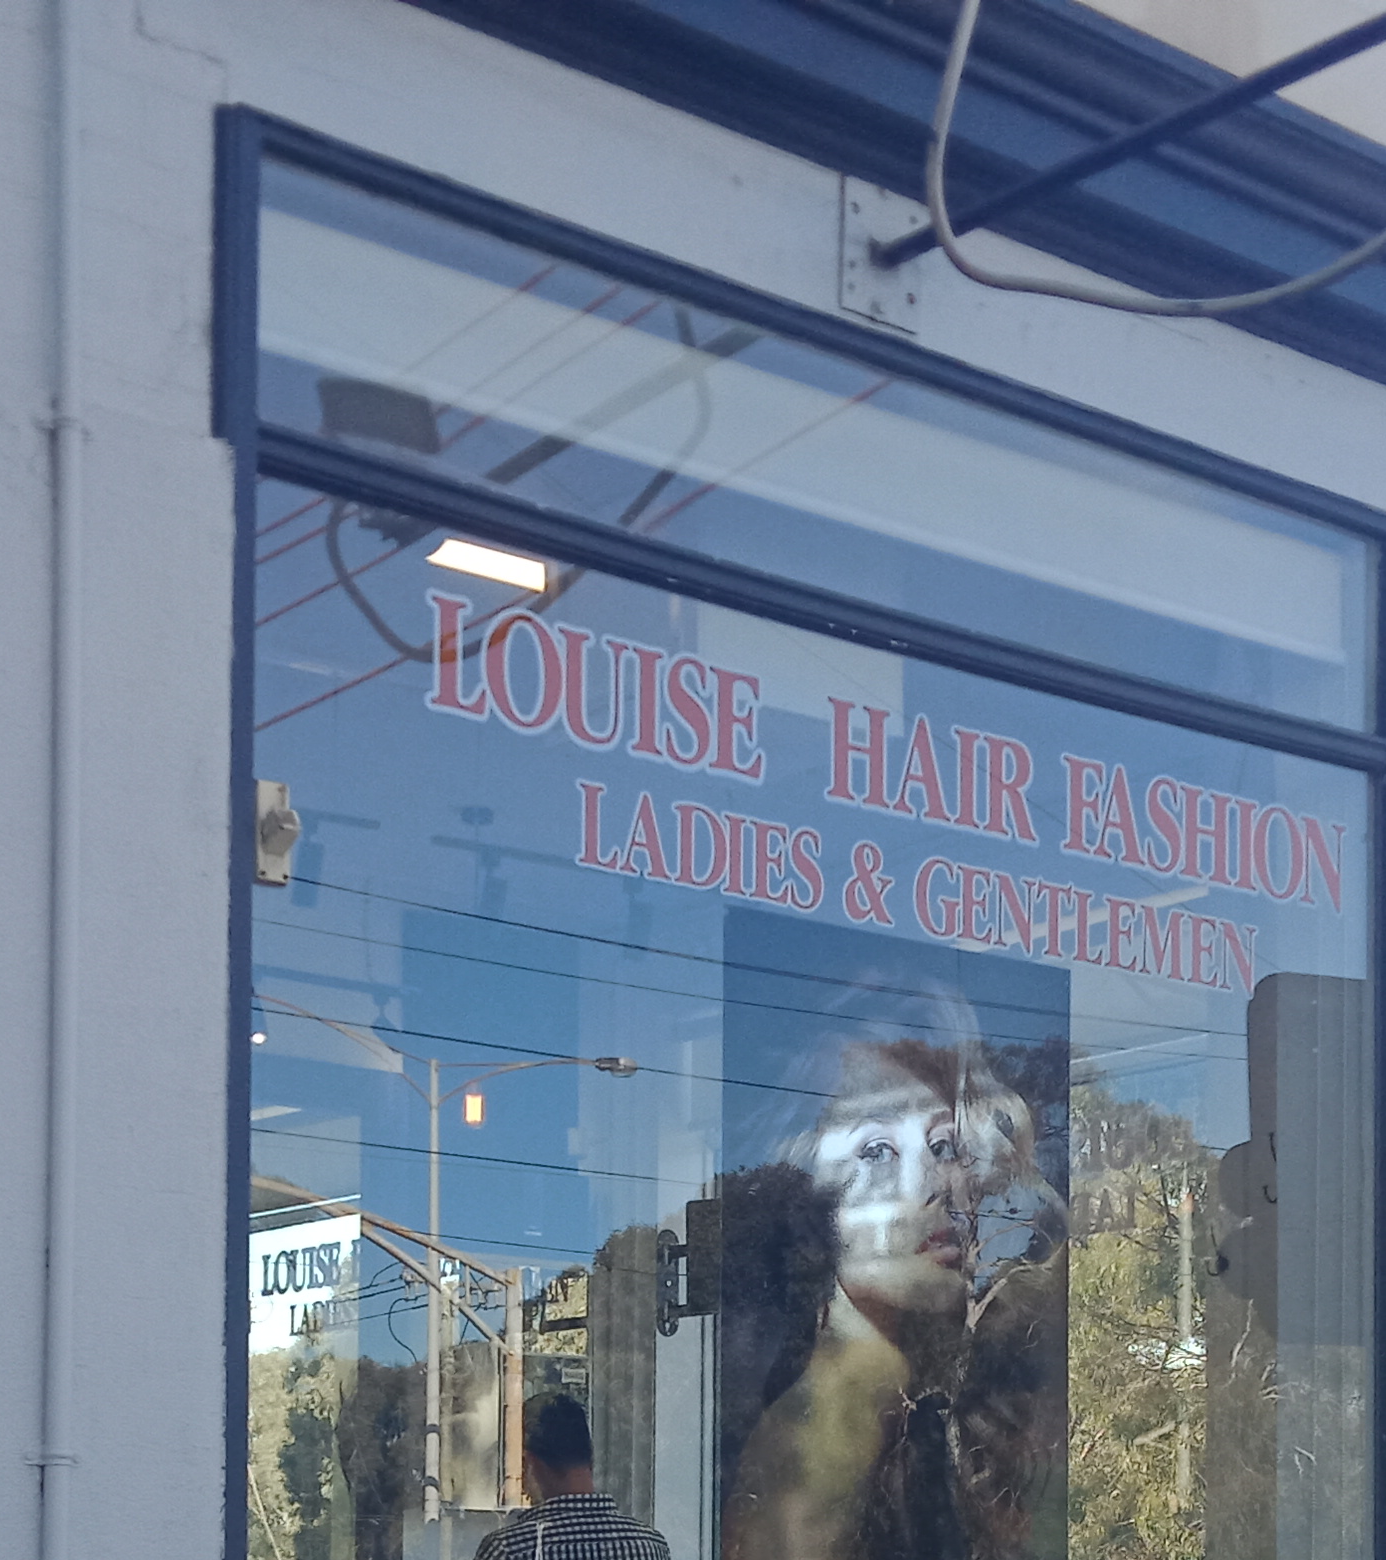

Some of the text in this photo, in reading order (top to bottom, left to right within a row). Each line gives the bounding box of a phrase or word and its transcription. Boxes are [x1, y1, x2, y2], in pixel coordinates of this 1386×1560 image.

[430, 592, 1346, 913] LOUISE HAIR FASHION
[578, 782, 1257, 998] LADIES & GENTLEMEN
[261, 1241, 341, 1296] LOUISE
